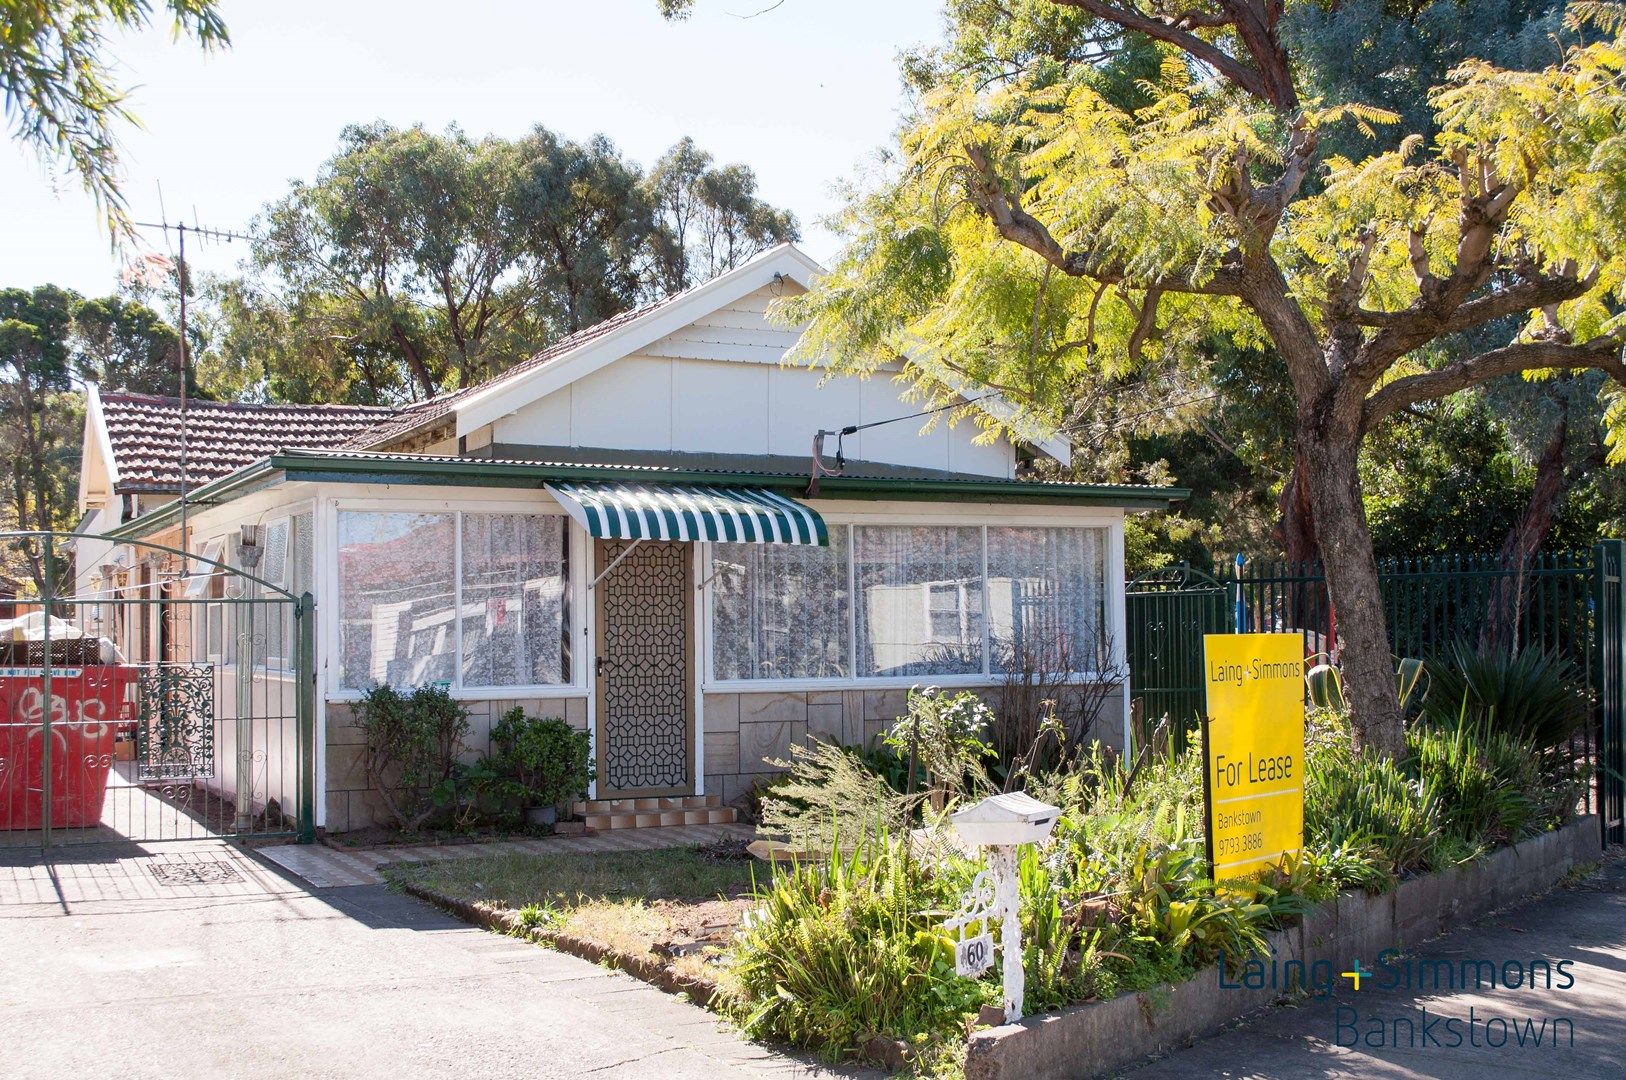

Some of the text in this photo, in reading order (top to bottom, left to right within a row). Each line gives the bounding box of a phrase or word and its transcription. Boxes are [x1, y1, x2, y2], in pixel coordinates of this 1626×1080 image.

[1216, 752, 1292, 788] For Lease
[1218, 810, 1261, 829] Bankstown
[1219, 832, 1263, 856] 9793 3886
[967, 941, 984, 966] 60
